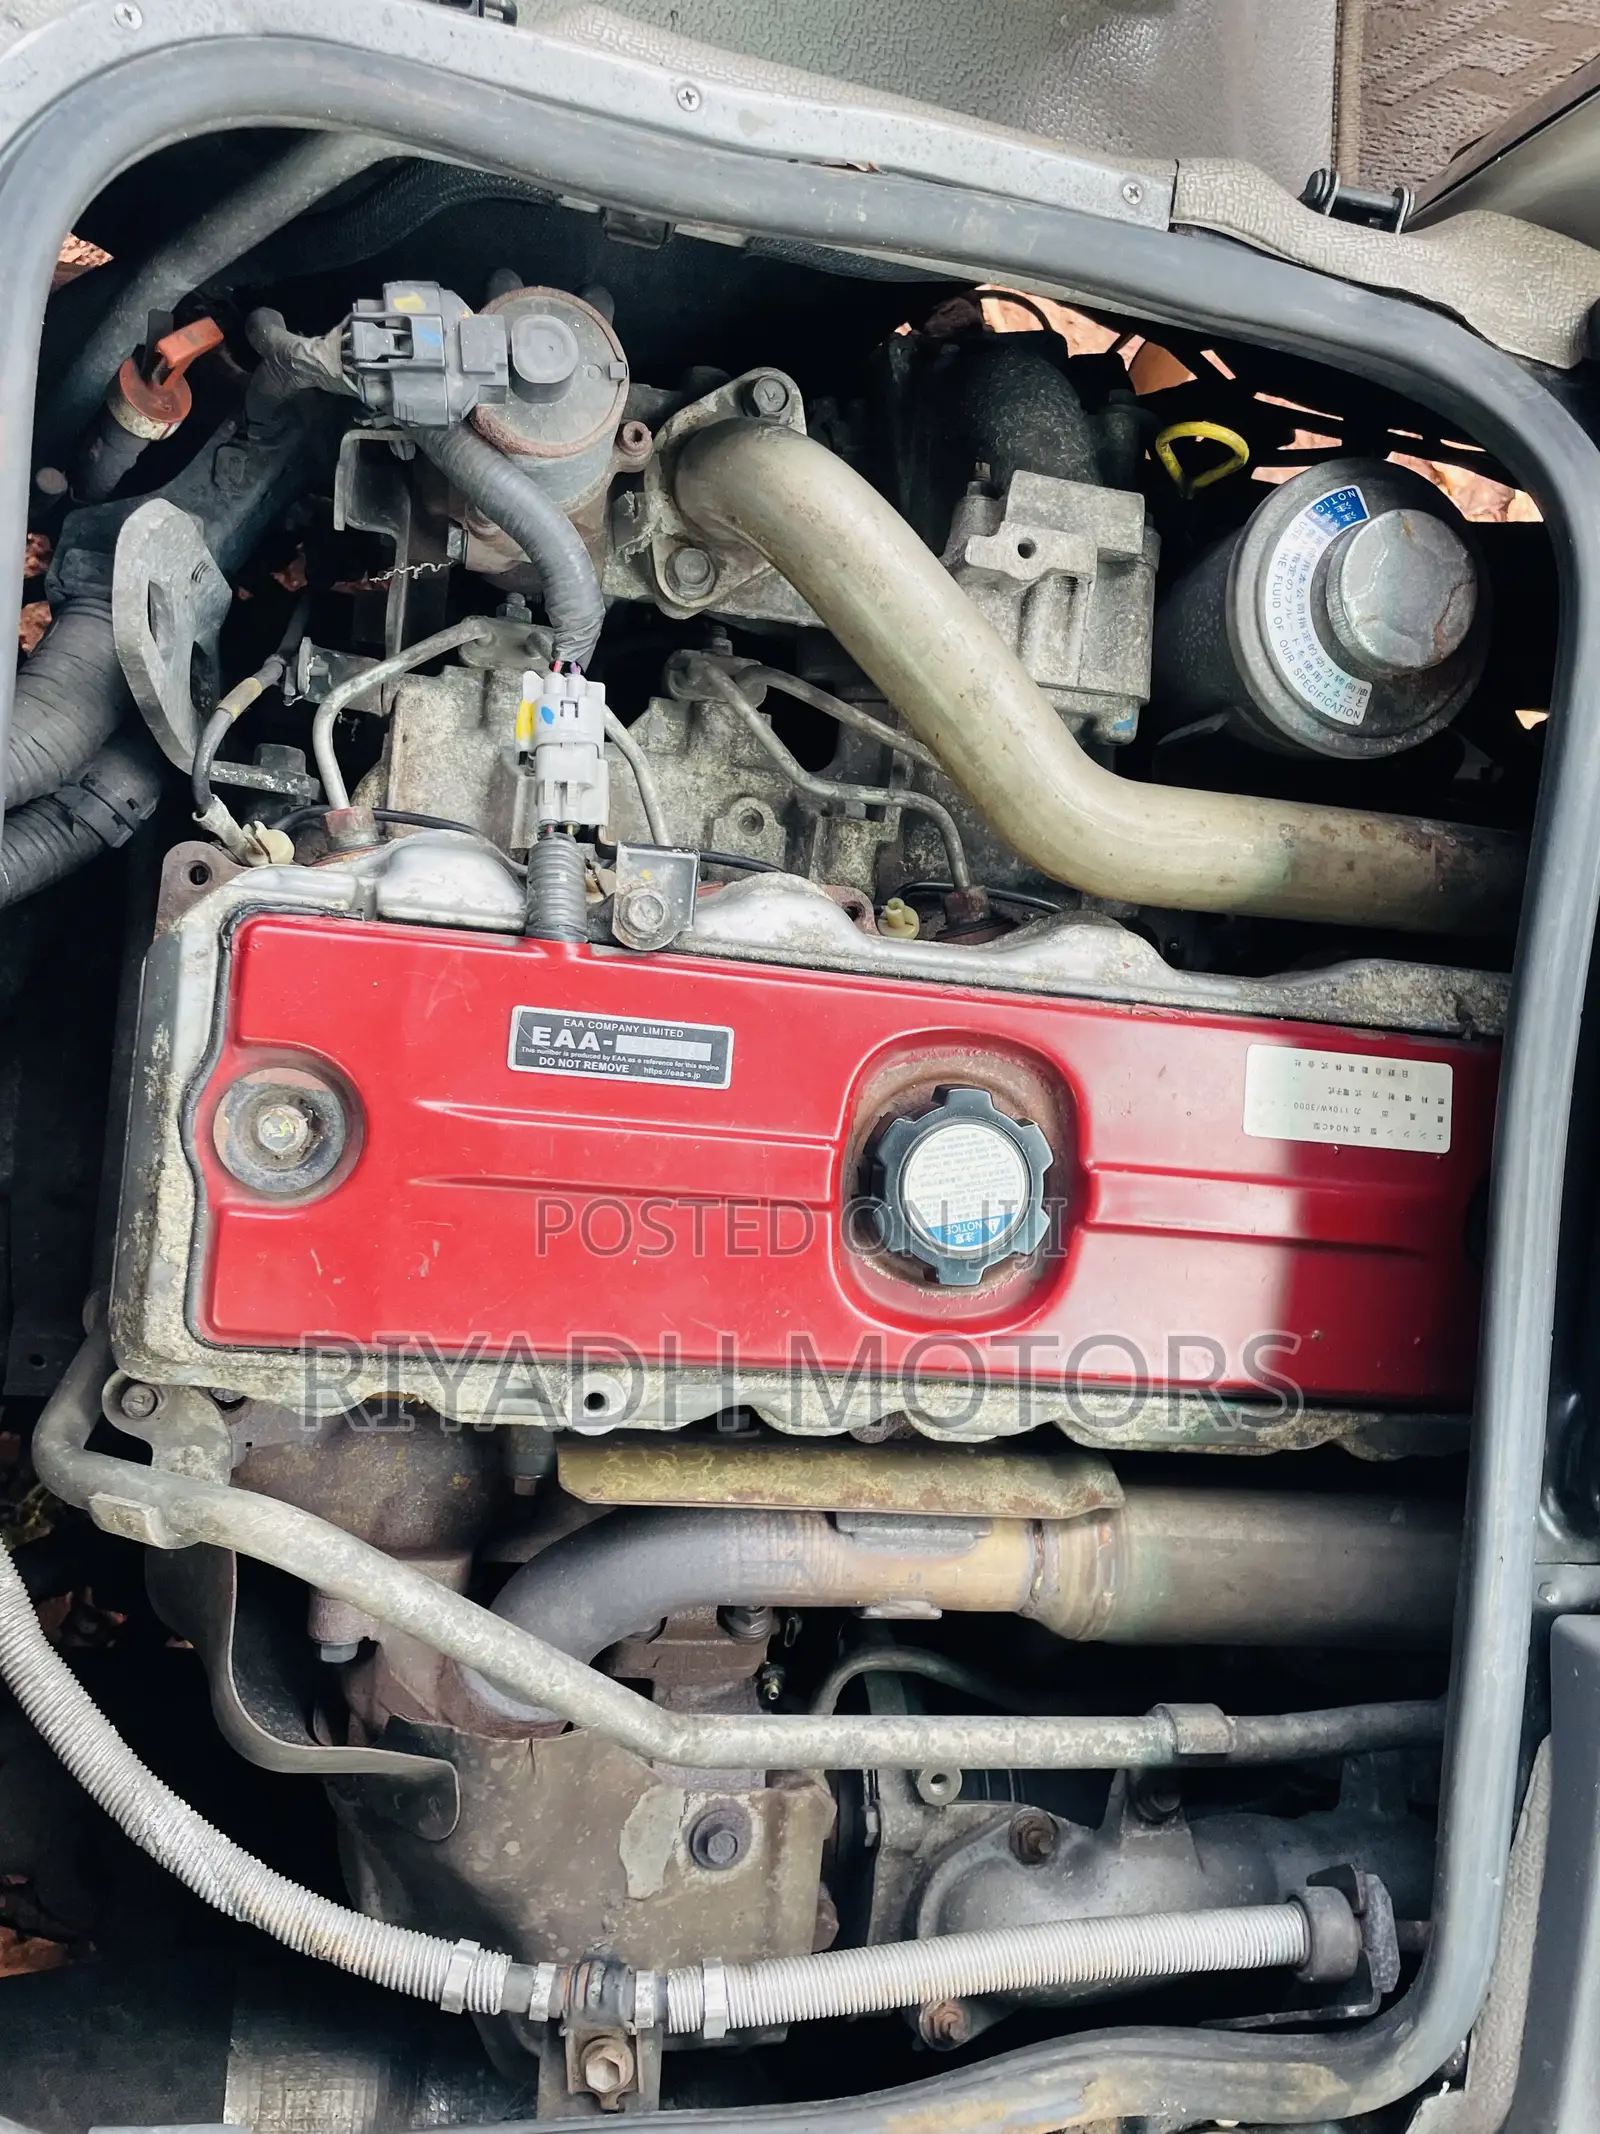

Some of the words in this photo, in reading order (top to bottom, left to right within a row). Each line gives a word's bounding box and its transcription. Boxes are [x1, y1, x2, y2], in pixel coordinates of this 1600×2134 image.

[1272, 574, 1283, 608] FLUID
[1273, 616, 1284, 631] OF
[1279, 639, 1295, 663] OUR
[1293, 668, 1361, 719] SPECIFICATION
[532, 1026, 613, 1052] EAA-
[563, 1018, 584, 1028] EAA
[587, 1020, 639, 1033] COMPANY
[643, 1026, 684, 1038] LIMITED
[521, 1046, 536, 1054] This
[537, 1048, 562, 1056] number
[570, 1052, 601, 1060] produced
[602, 1054, 611, 1062] by
[643, 1059, 673, 1067] reference
[675, 1060, 684, 1068] for
[685, 1061, 697, 1069] this
[698, 1064, 720, 1072] engine
[538, 1056, 556, 1066] DO
[558, 1058, 582, 1069] NOT
[583, 1060, 630, 1073] REMOVE
[643, 1067, 701, 1080] https://eaa-s.jp
[945, 1221, 982, 1235] NOTICE
